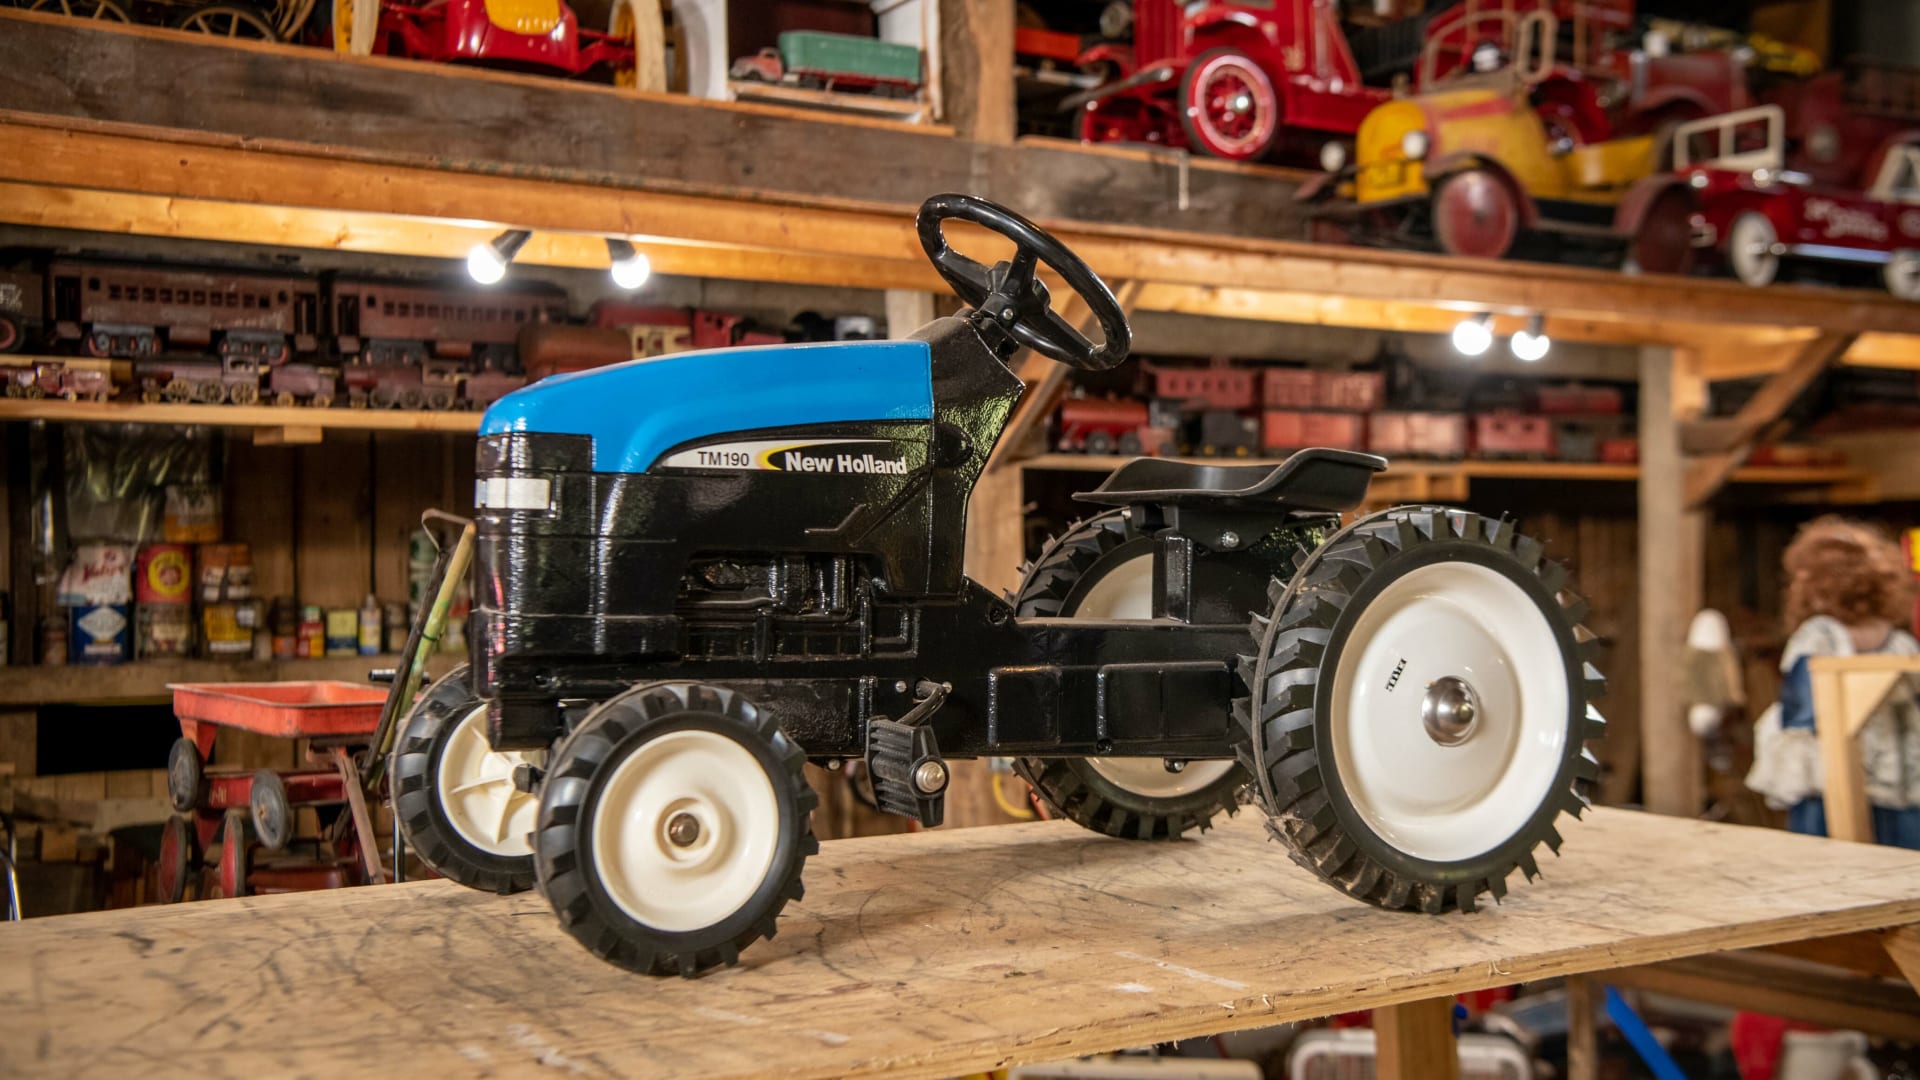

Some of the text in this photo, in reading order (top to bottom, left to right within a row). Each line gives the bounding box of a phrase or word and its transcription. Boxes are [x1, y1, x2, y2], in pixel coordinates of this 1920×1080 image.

[697, 451, 750, 467] TM190
[785, 451, 907, 474] New Holland
